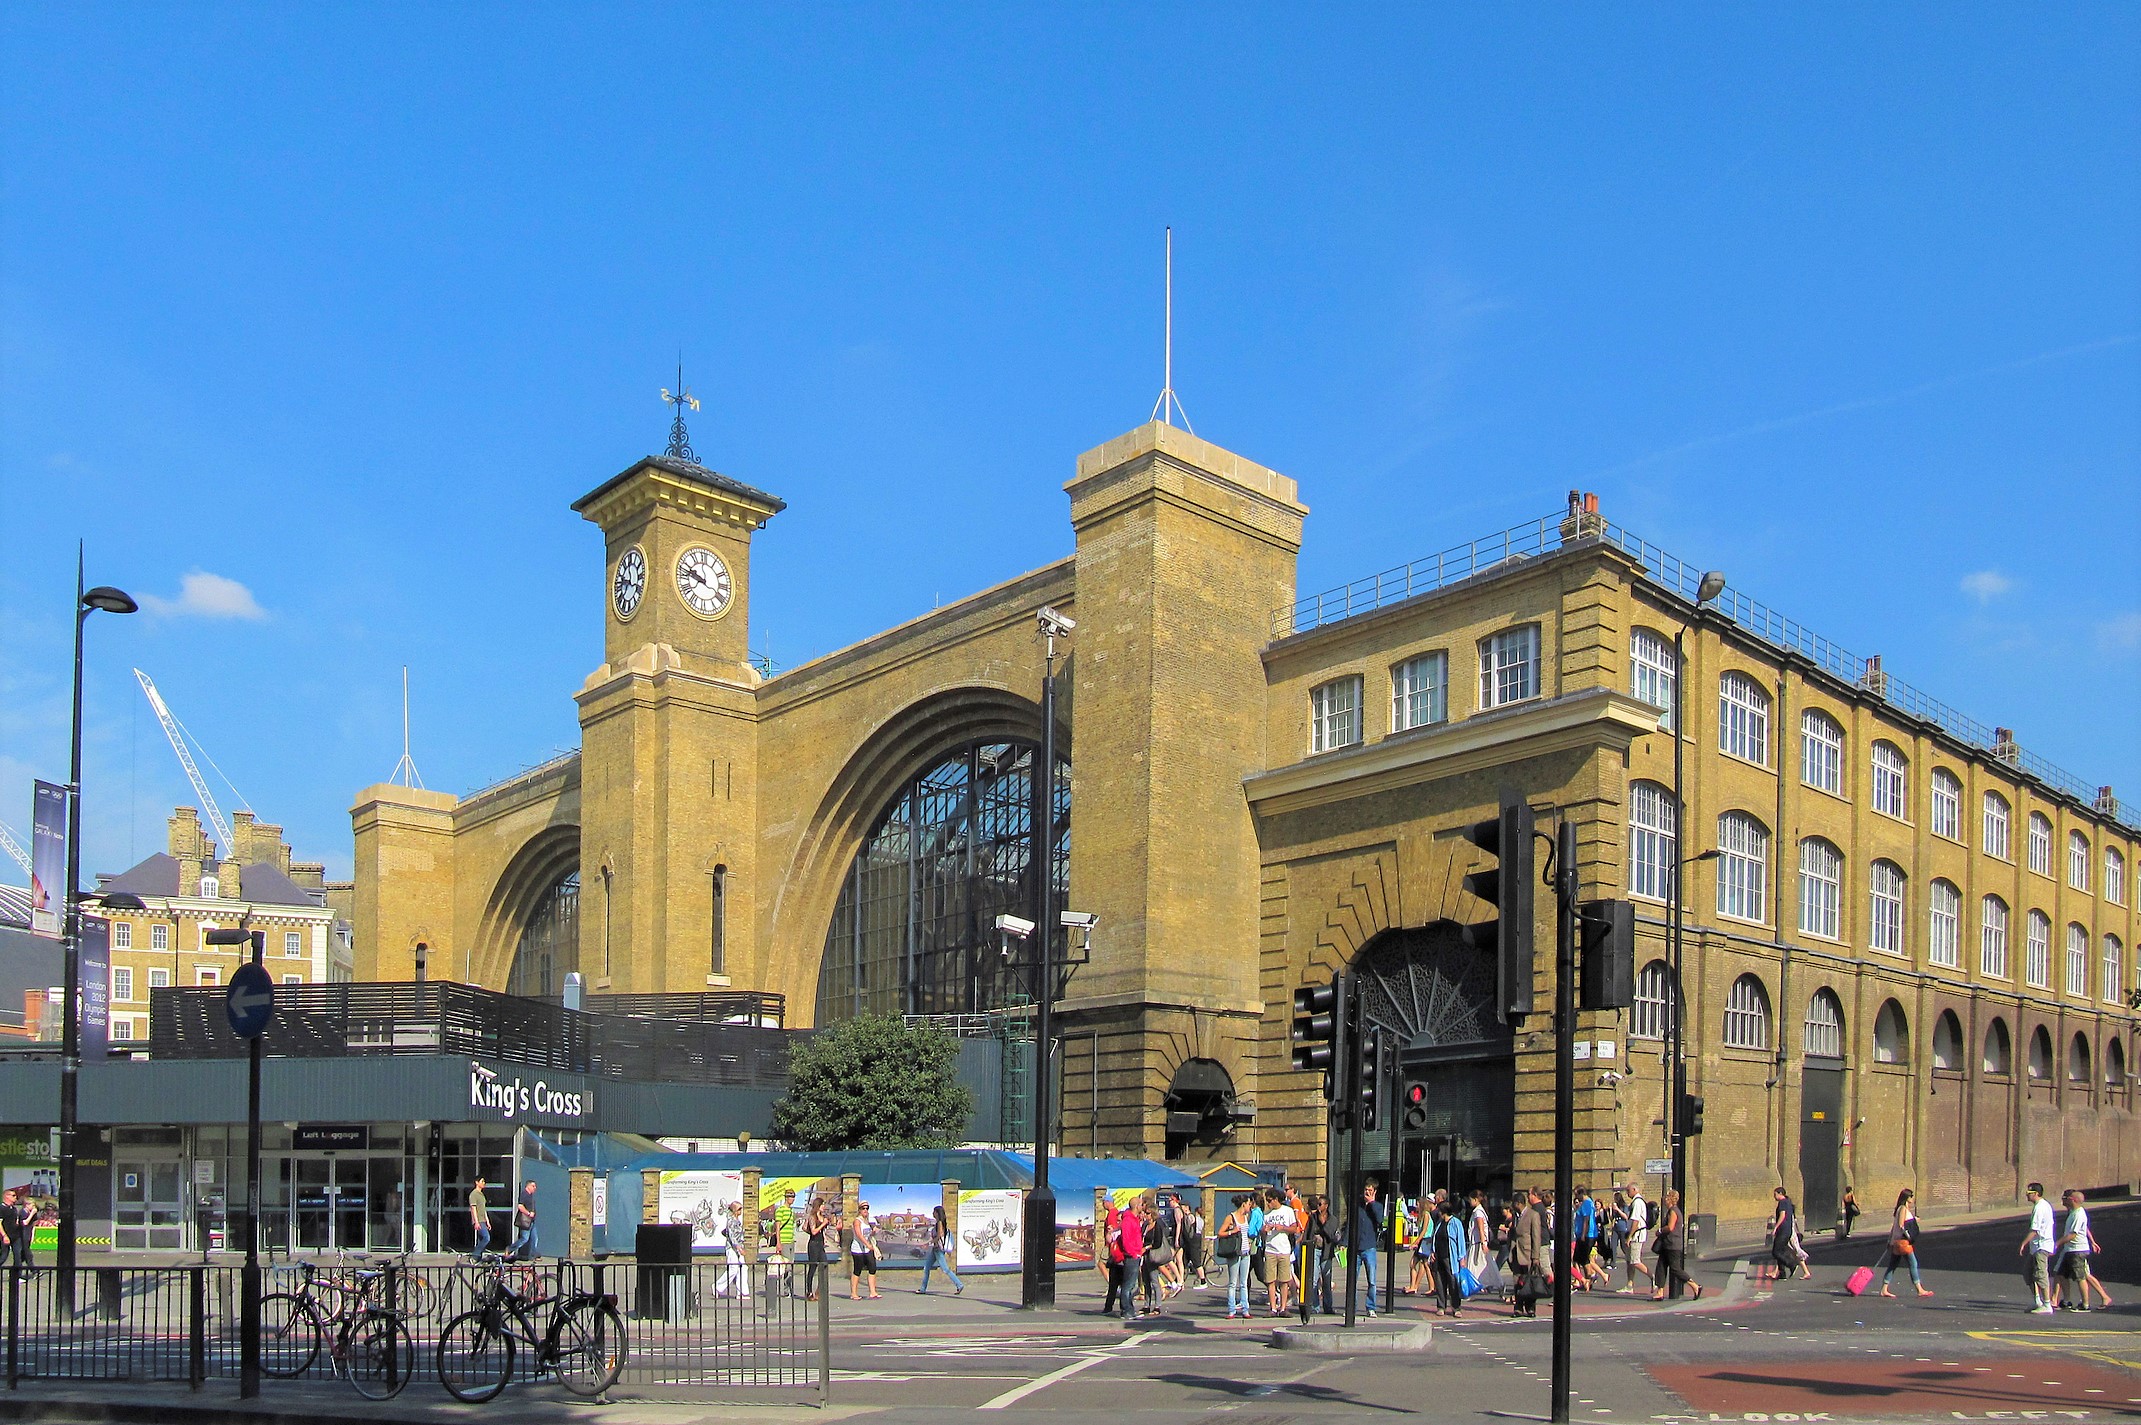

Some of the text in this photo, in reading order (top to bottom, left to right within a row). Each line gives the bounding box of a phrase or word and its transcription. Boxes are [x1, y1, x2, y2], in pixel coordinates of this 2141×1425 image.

[86, 980, 107, 991] London
[91, 992, 107, 1003] 2012
[84, 1003, 107, 1016] Olympic
[87, 1015, 106, 1026] Games
[471, 1071, 582, 1118] King's Cross
[302, 1131, 319, 1139] Left
[1709, 1411, 1836, 1422] LOOK
[1951, 1410, 2090, 1420] LEFT
